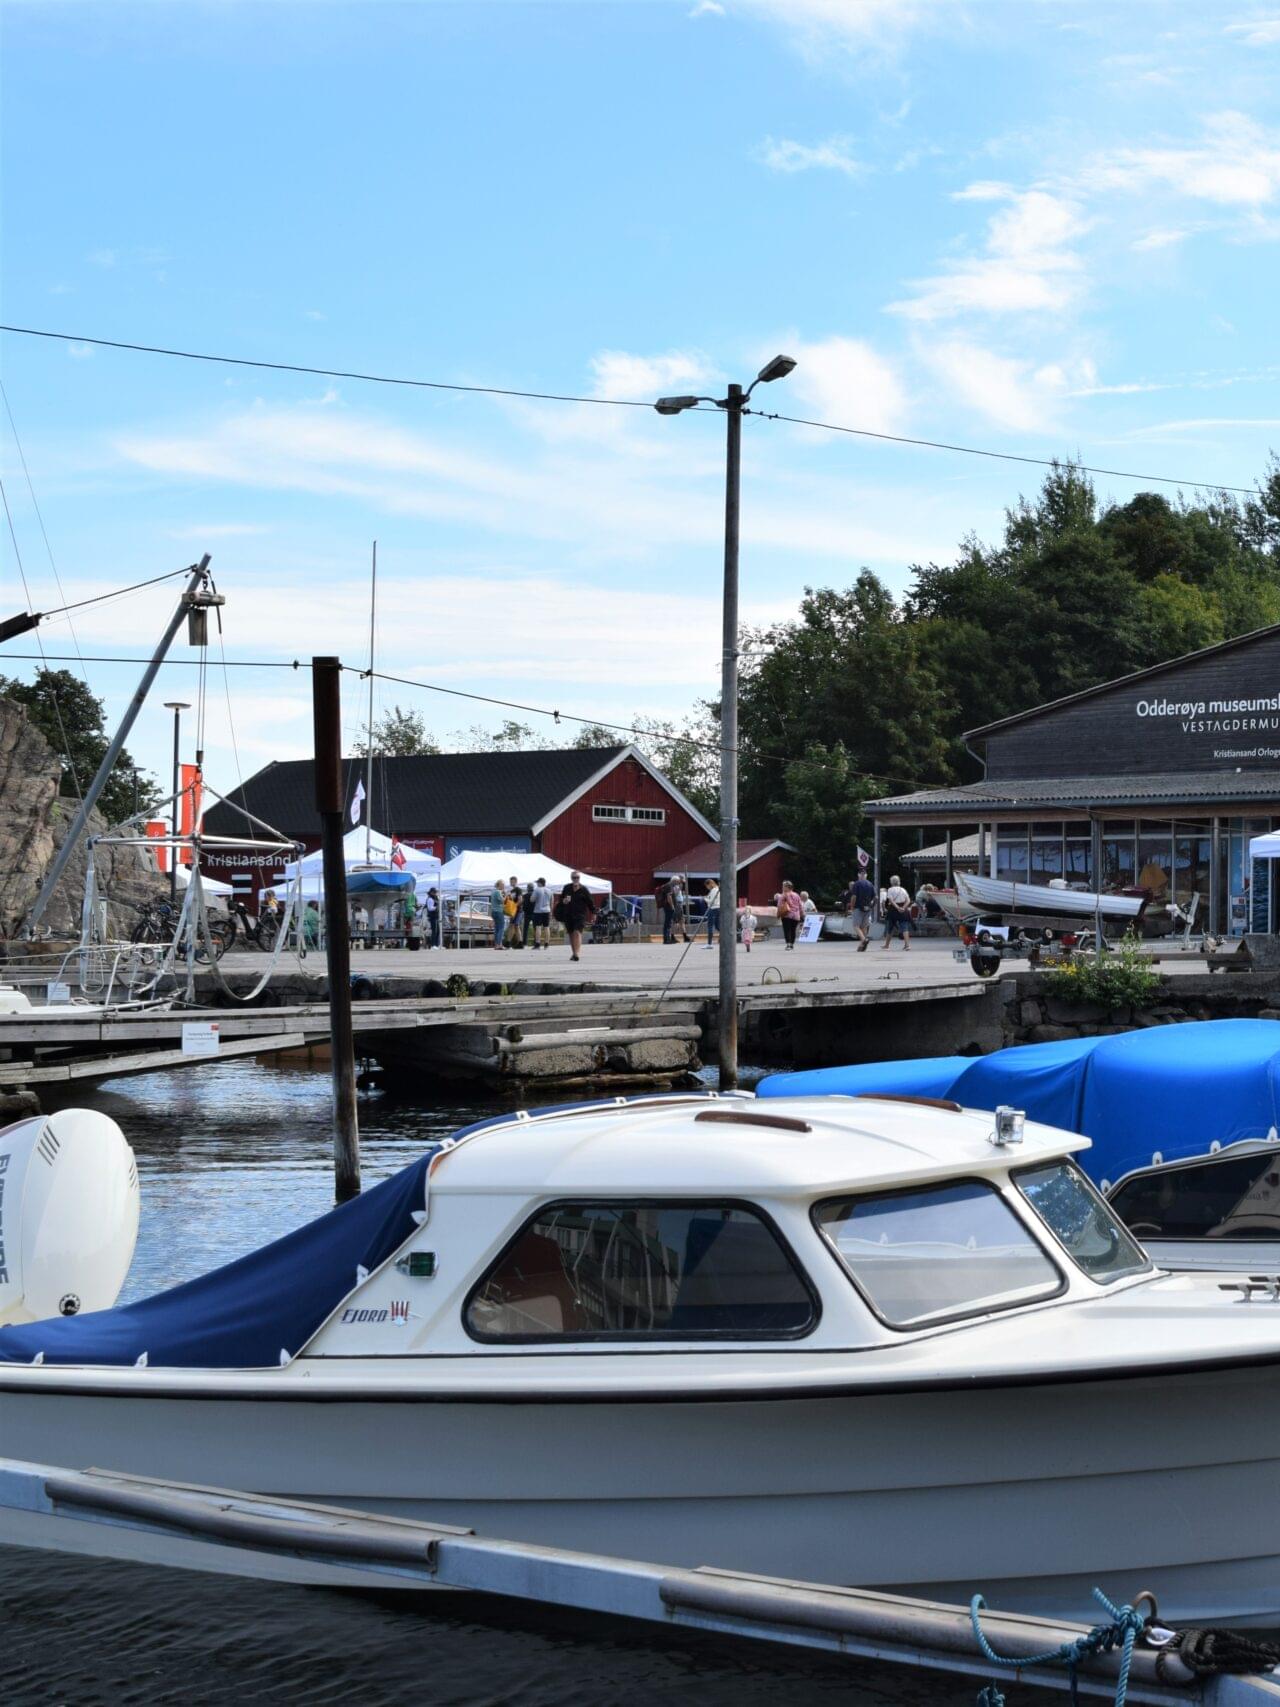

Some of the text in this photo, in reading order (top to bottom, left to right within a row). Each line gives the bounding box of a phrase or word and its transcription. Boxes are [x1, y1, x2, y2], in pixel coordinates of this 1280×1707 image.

[1136, 698, 1205, 719] Odderøya
[1213, 748, 1257, 758] Kristiansand
[207, 853, 292, 867] Kristiansand
